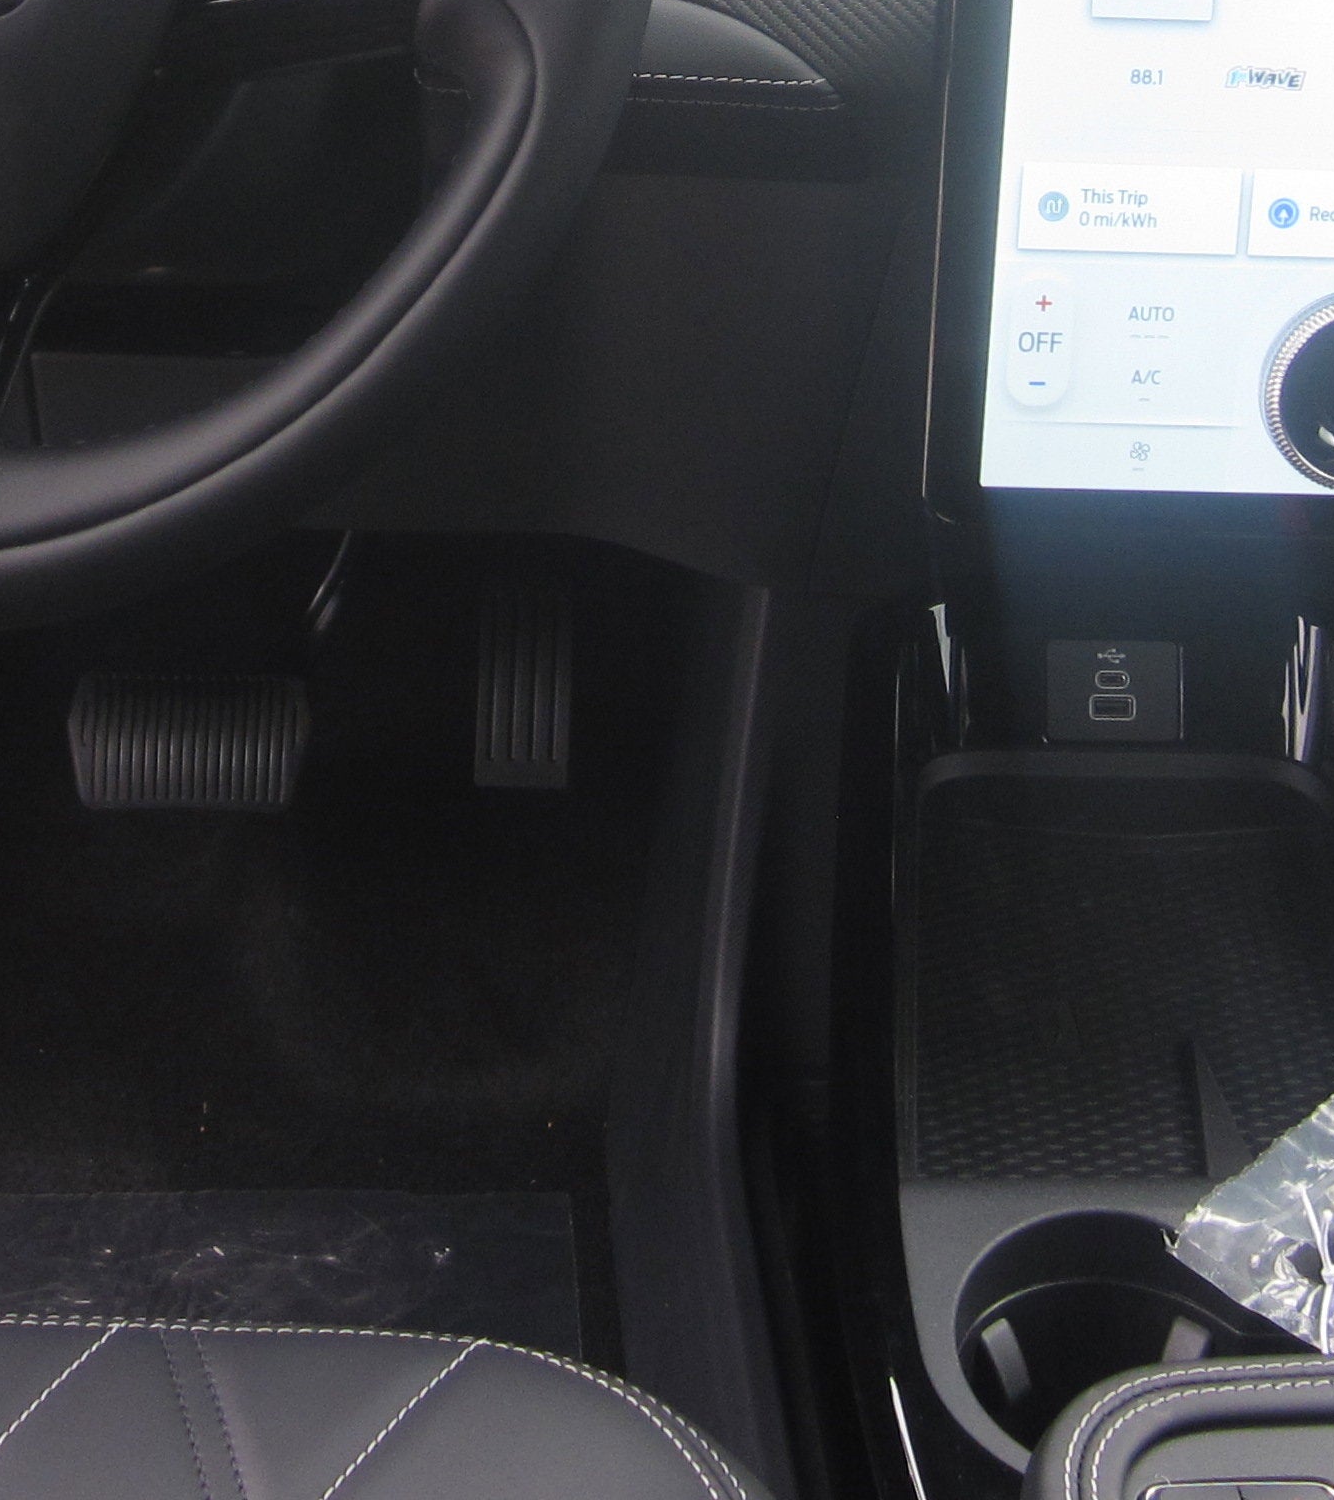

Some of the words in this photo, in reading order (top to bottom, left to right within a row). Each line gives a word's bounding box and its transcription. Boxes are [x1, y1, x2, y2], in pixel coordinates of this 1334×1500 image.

[1129, 68, 1164, 86] 88.1
[1080, 188, 1114, 205] This
[1118, 190, 1149, 209] Trip
[1079, 211, 1090, 227] 0
[1093, 212, 1158, 229] mi/kWh
[1128, 306, 1175, 323] AUTO
[1018, 332, 1063, 354] OFF
[1131, 369, 1162, 386] A/C
